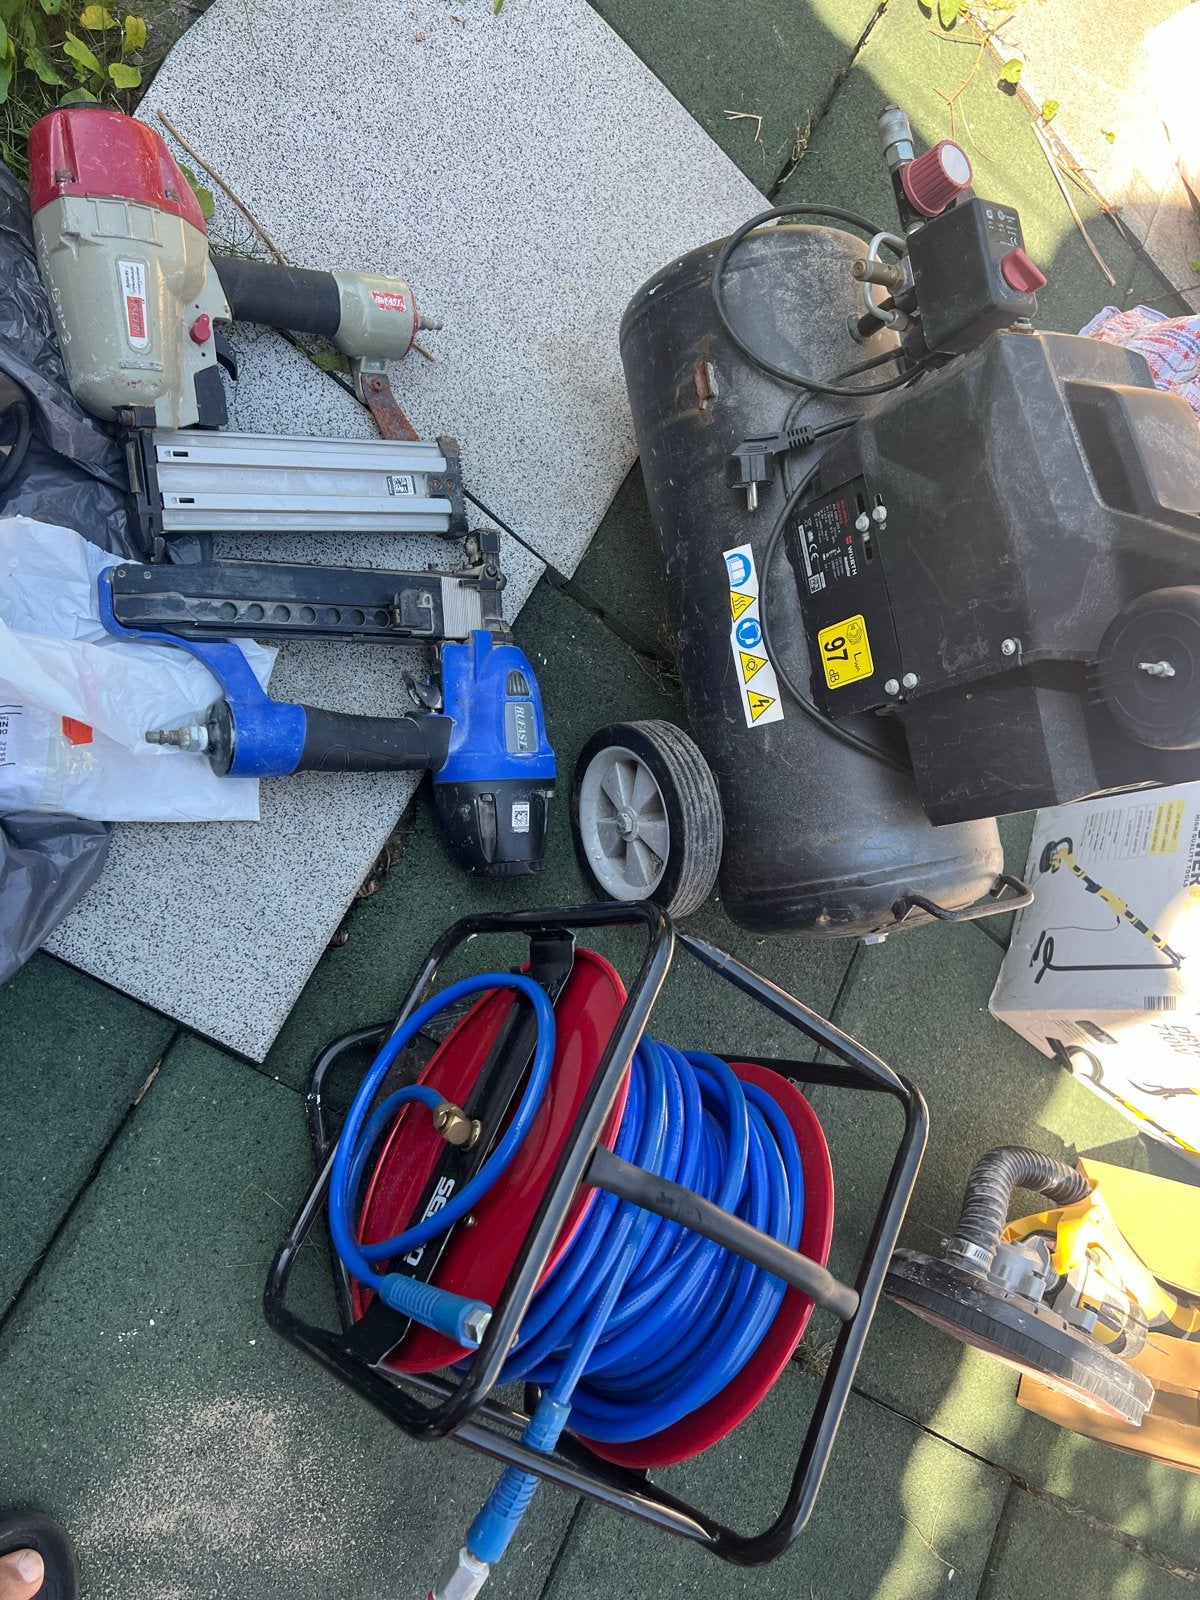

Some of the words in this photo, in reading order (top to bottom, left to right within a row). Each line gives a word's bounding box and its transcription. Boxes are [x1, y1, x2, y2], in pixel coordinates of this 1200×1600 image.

[824, 636, 849, 662] 97
[828, 668, 840, 683] dB
[515, 705, 528, 750] RUFAST
[1187, 833, 1198, 863] QUALITY
[1182, 865, 1192, 888] TOOLS
